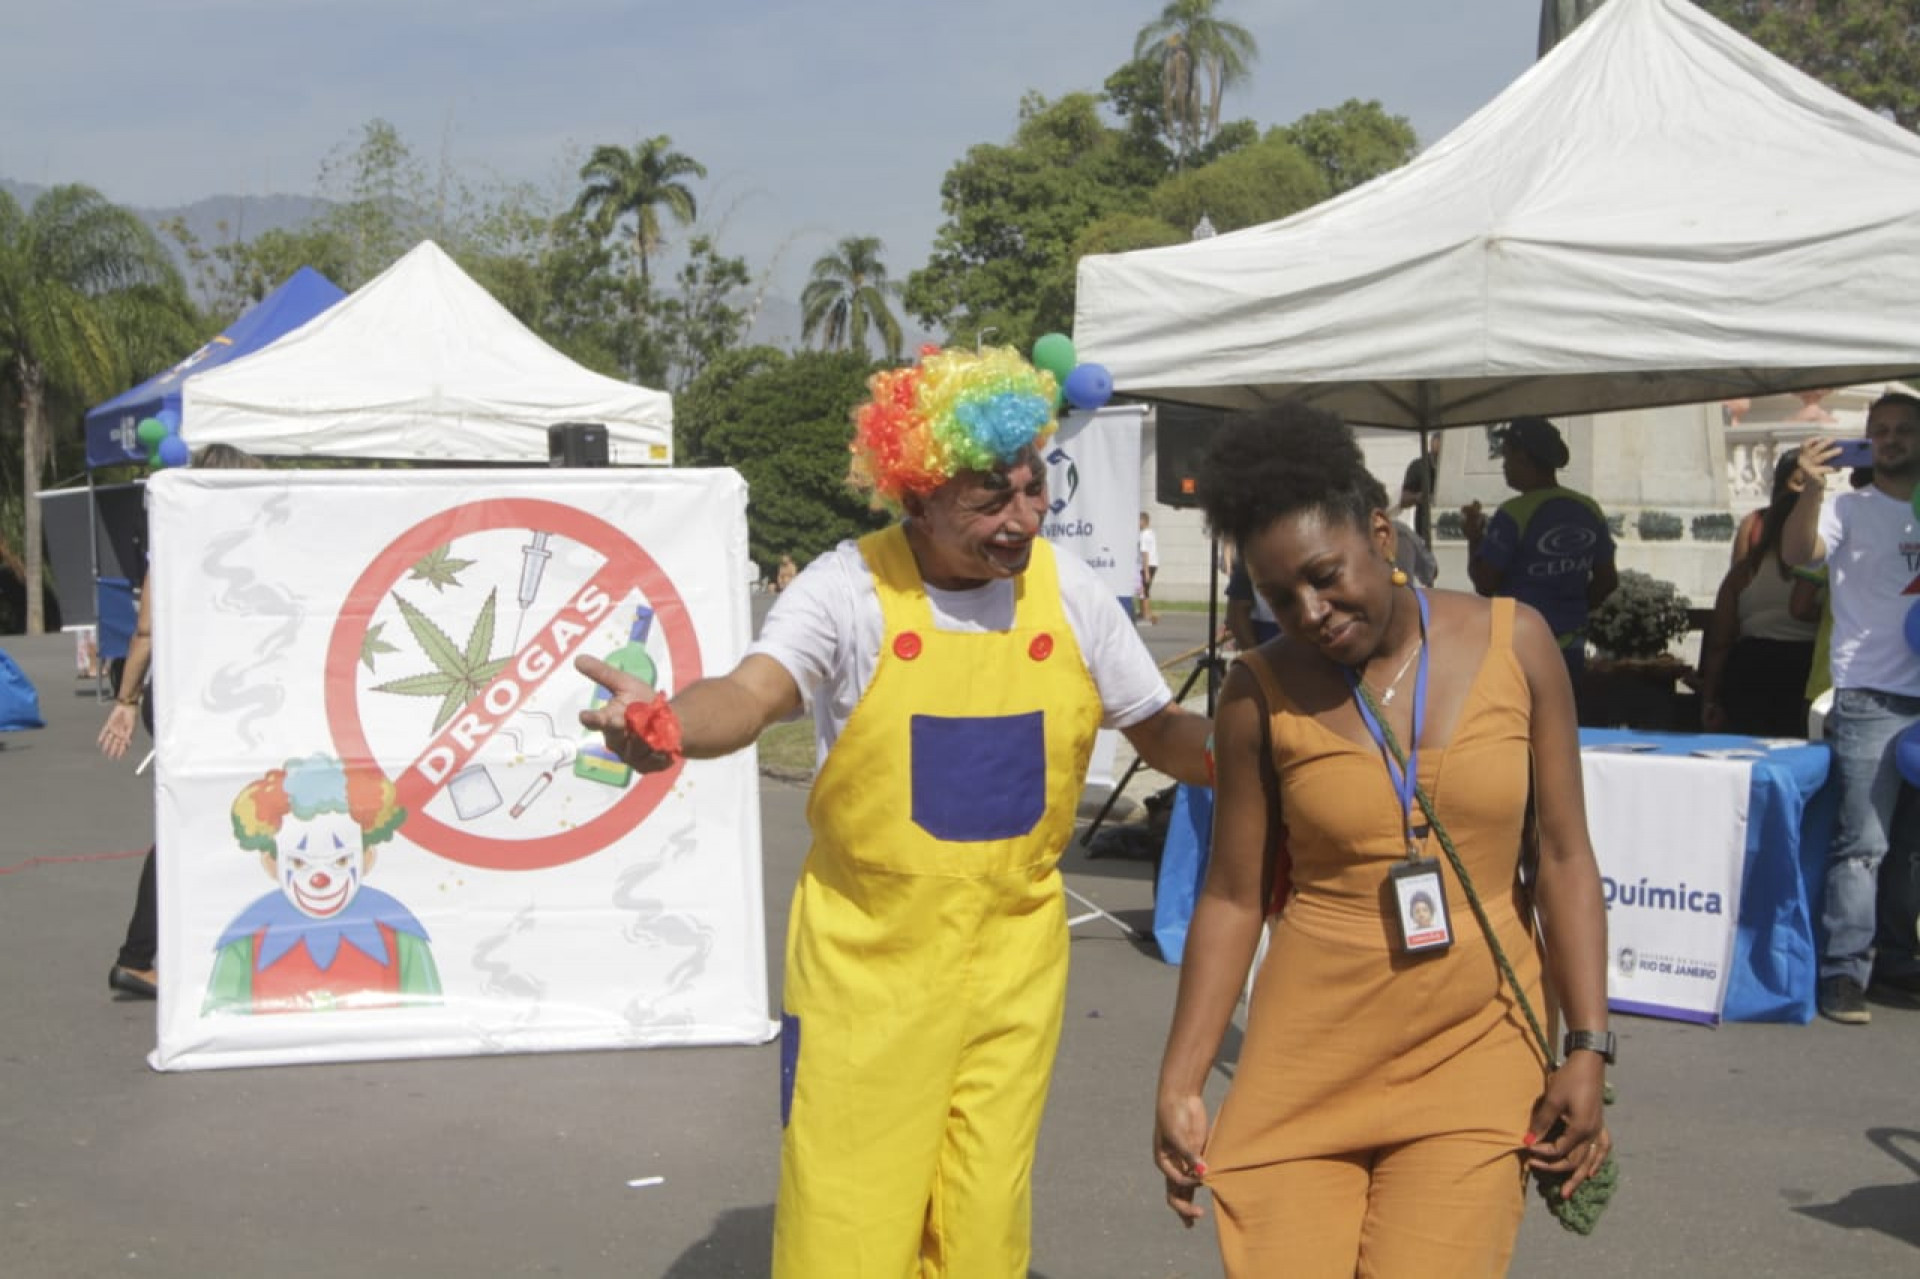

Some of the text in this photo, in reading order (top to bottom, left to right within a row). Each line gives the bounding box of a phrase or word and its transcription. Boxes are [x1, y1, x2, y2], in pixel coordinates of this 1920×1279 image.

[416, 585, 611, 785] DROGAS
[1601, 876, 1723, 915] Química
[1639, 960, 1658, 972] RIO
[1659, 962, 1673, 974] DE
[1674, 966, 1717, 980] JANEIRO
